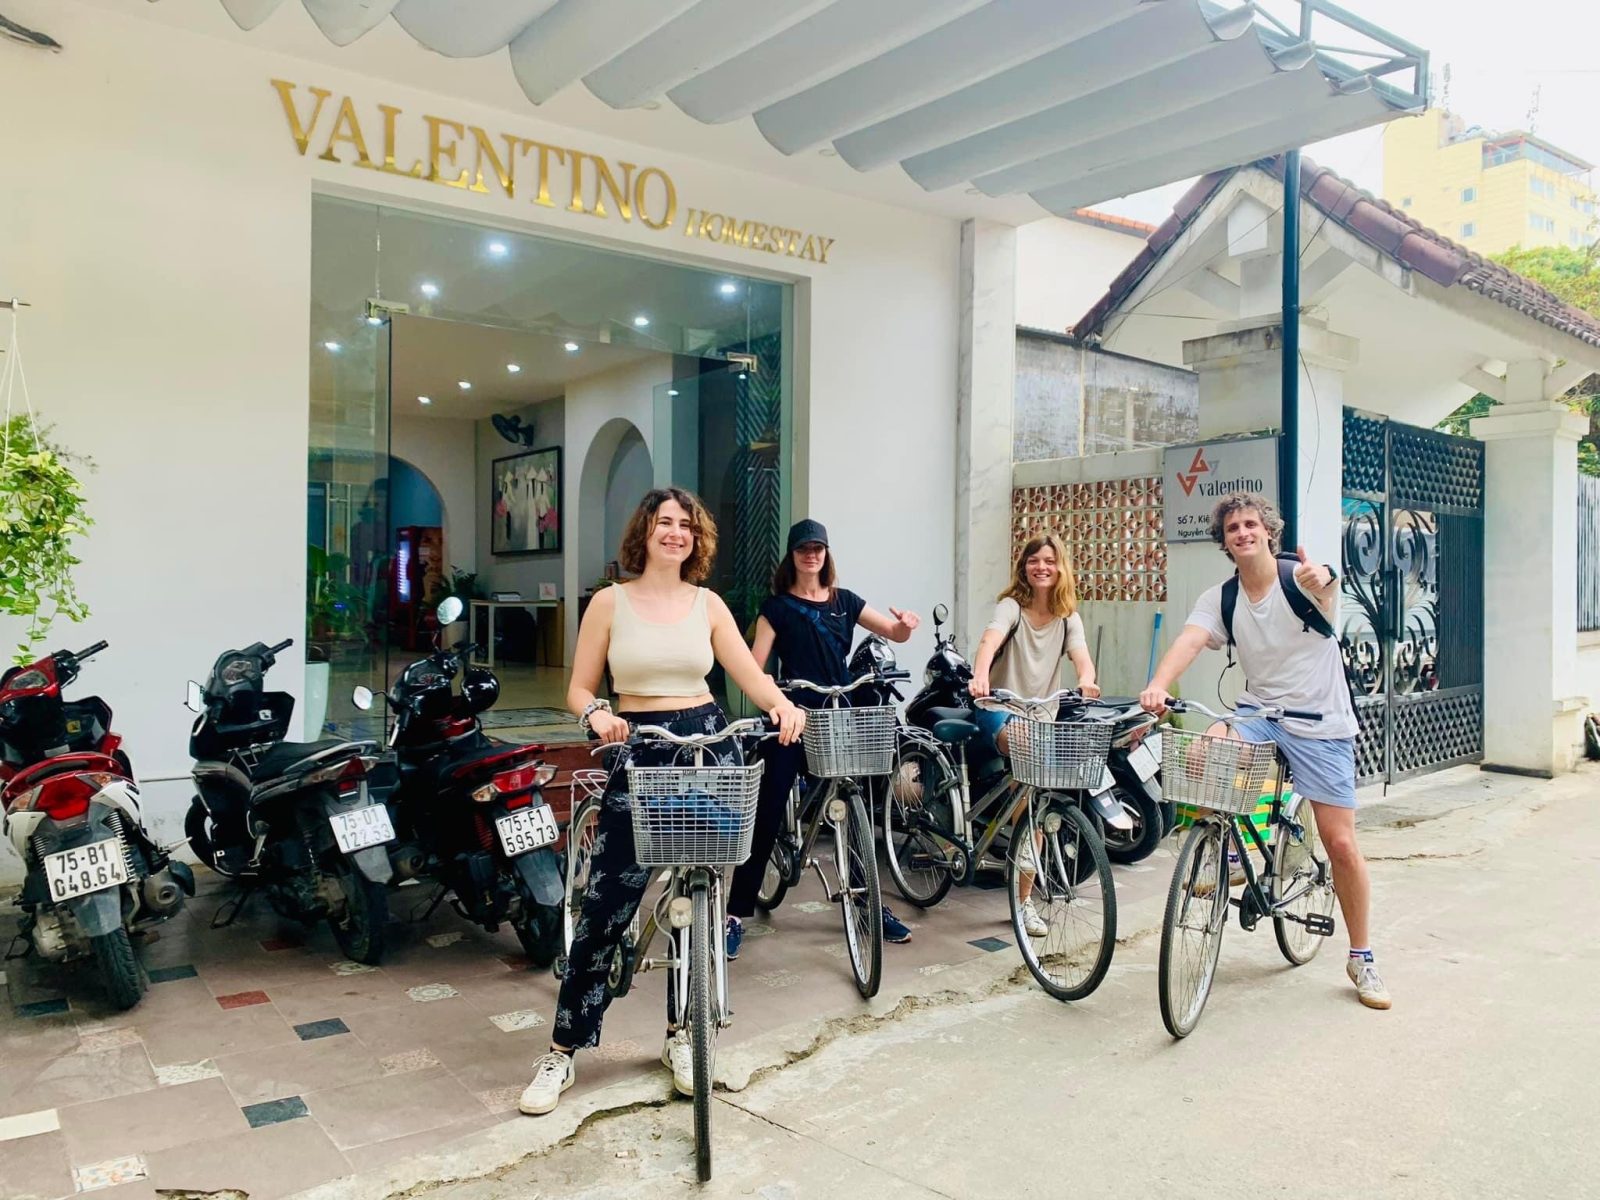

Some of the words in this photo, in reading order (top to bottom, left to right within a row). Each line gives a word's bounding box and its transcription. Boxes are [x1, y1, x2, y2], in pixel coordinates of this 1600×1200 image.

[270, 78, 677, 230] VALENTINO
[685, 208, 835, 264] HOMESTAY
[505, 825, 556, 854] 595.73
[56, 843, 108, 873] 75-B1
